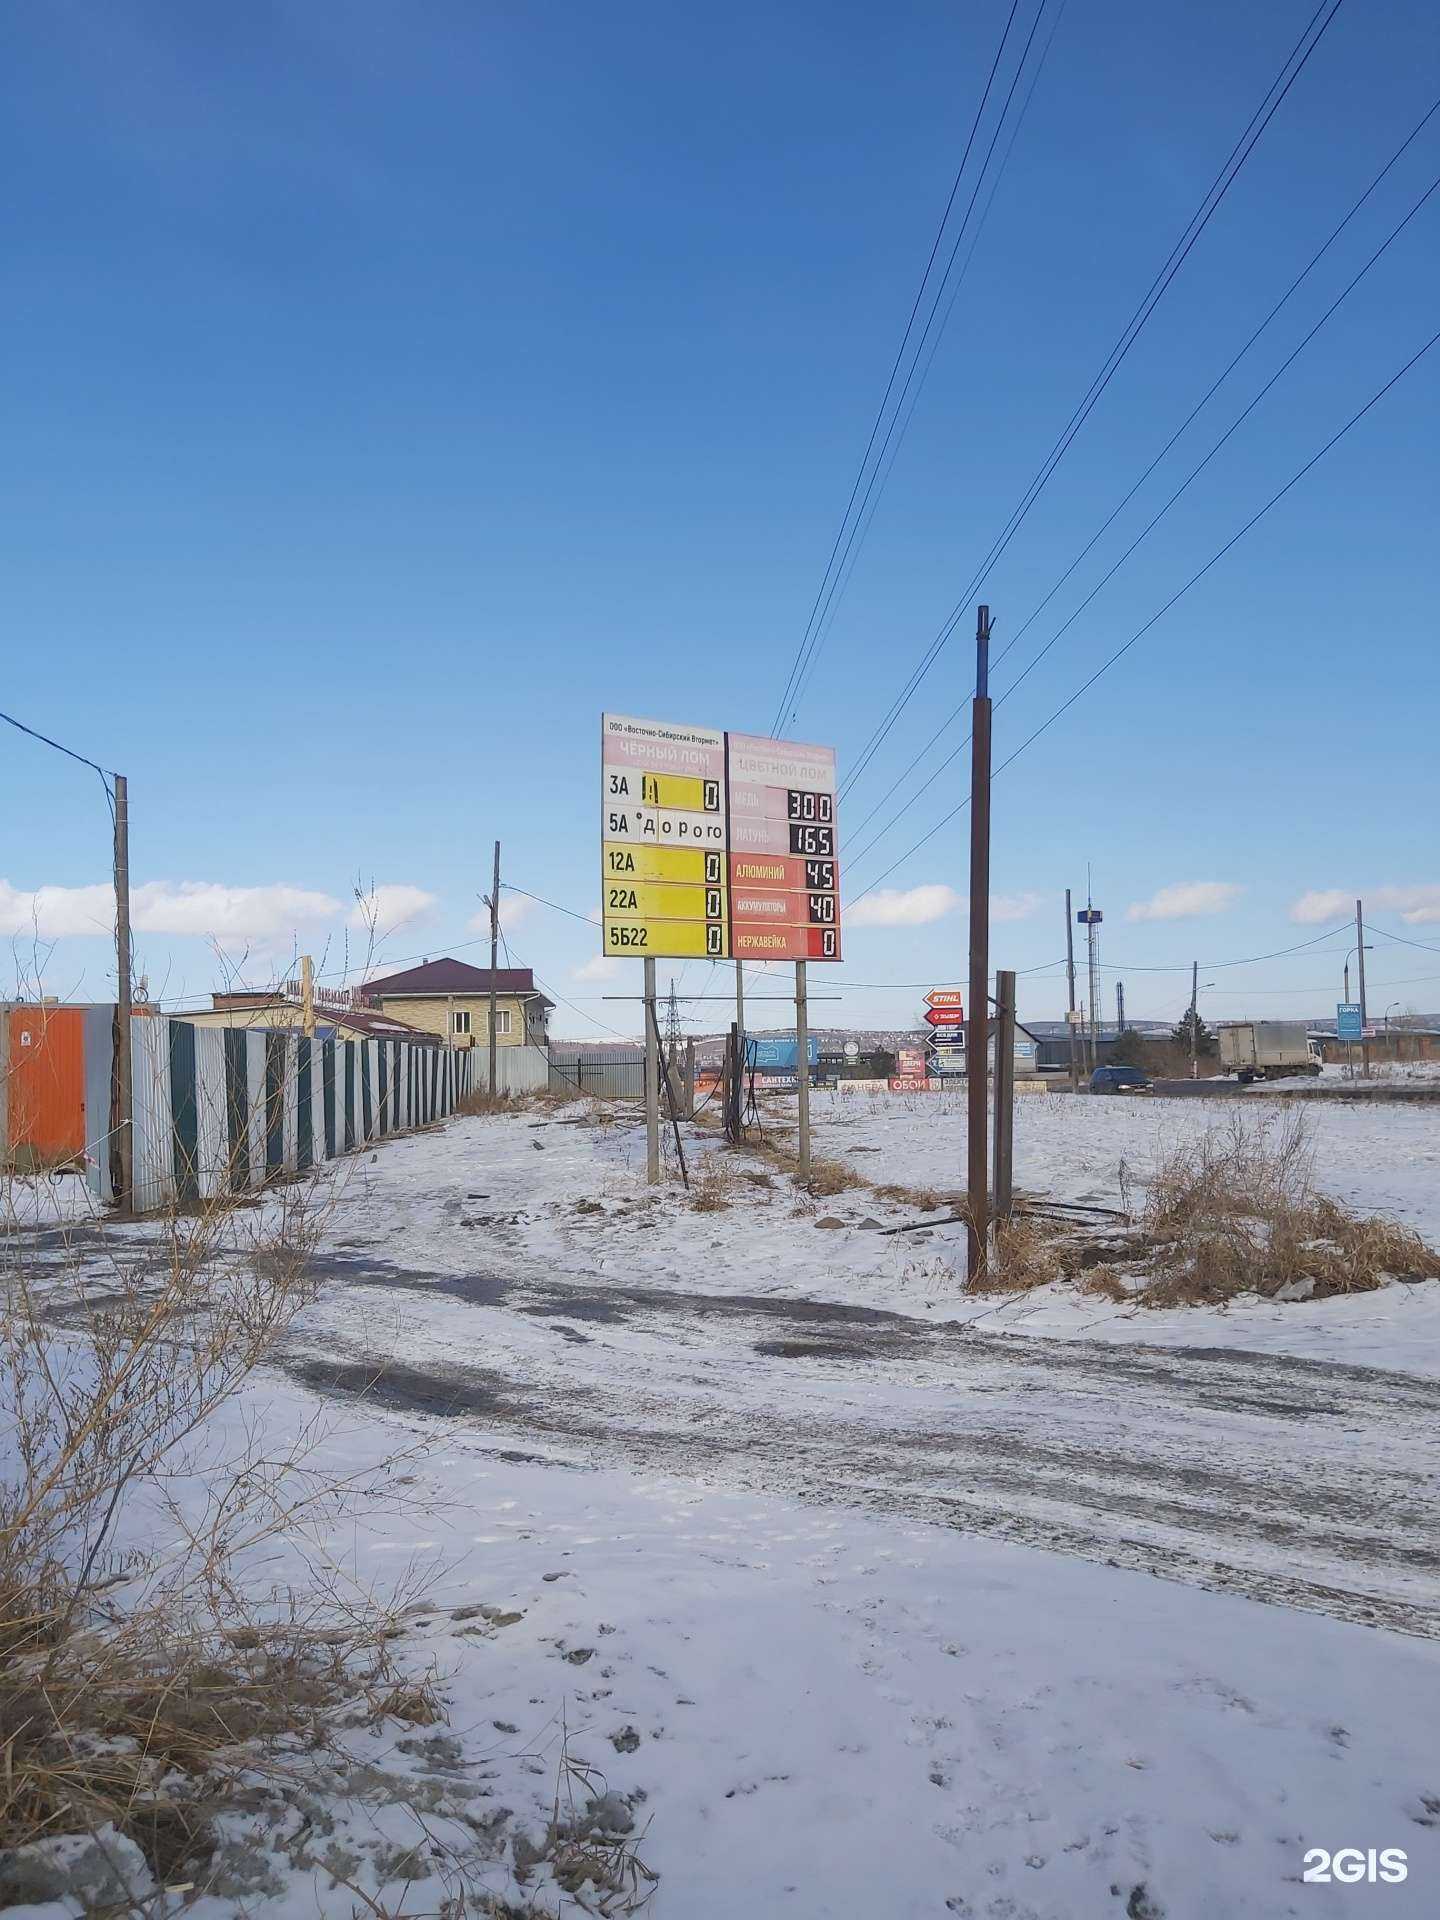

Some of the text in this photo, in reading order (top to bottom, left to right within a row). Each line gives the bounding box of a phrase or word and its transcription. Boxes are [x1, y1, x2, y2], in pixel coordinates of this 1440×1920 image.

[609, 722, 623, 732] ООО
[624, 724, 690, 742] «Восточно-Сибирский
[680, 750, 710, 765] ЛОМ
[800, 766, 827, 780] ЛОМ
[705, 782, 718, 810] 0
[790, 792, 831, 821] 300
[798, 828, 830, 854] 165
[609, 852, 719, 880] 12А 0
[736, 862, 833, 888] АЛЮМИНИЙ 45
[609, 890, 720, 917] 22А 0
[810, 896, 834, 922] 40
[610, 926, 721, 953] 5Б22 0
[737, 930, 835, 956] НЕРЖАВЕЙКА 0
